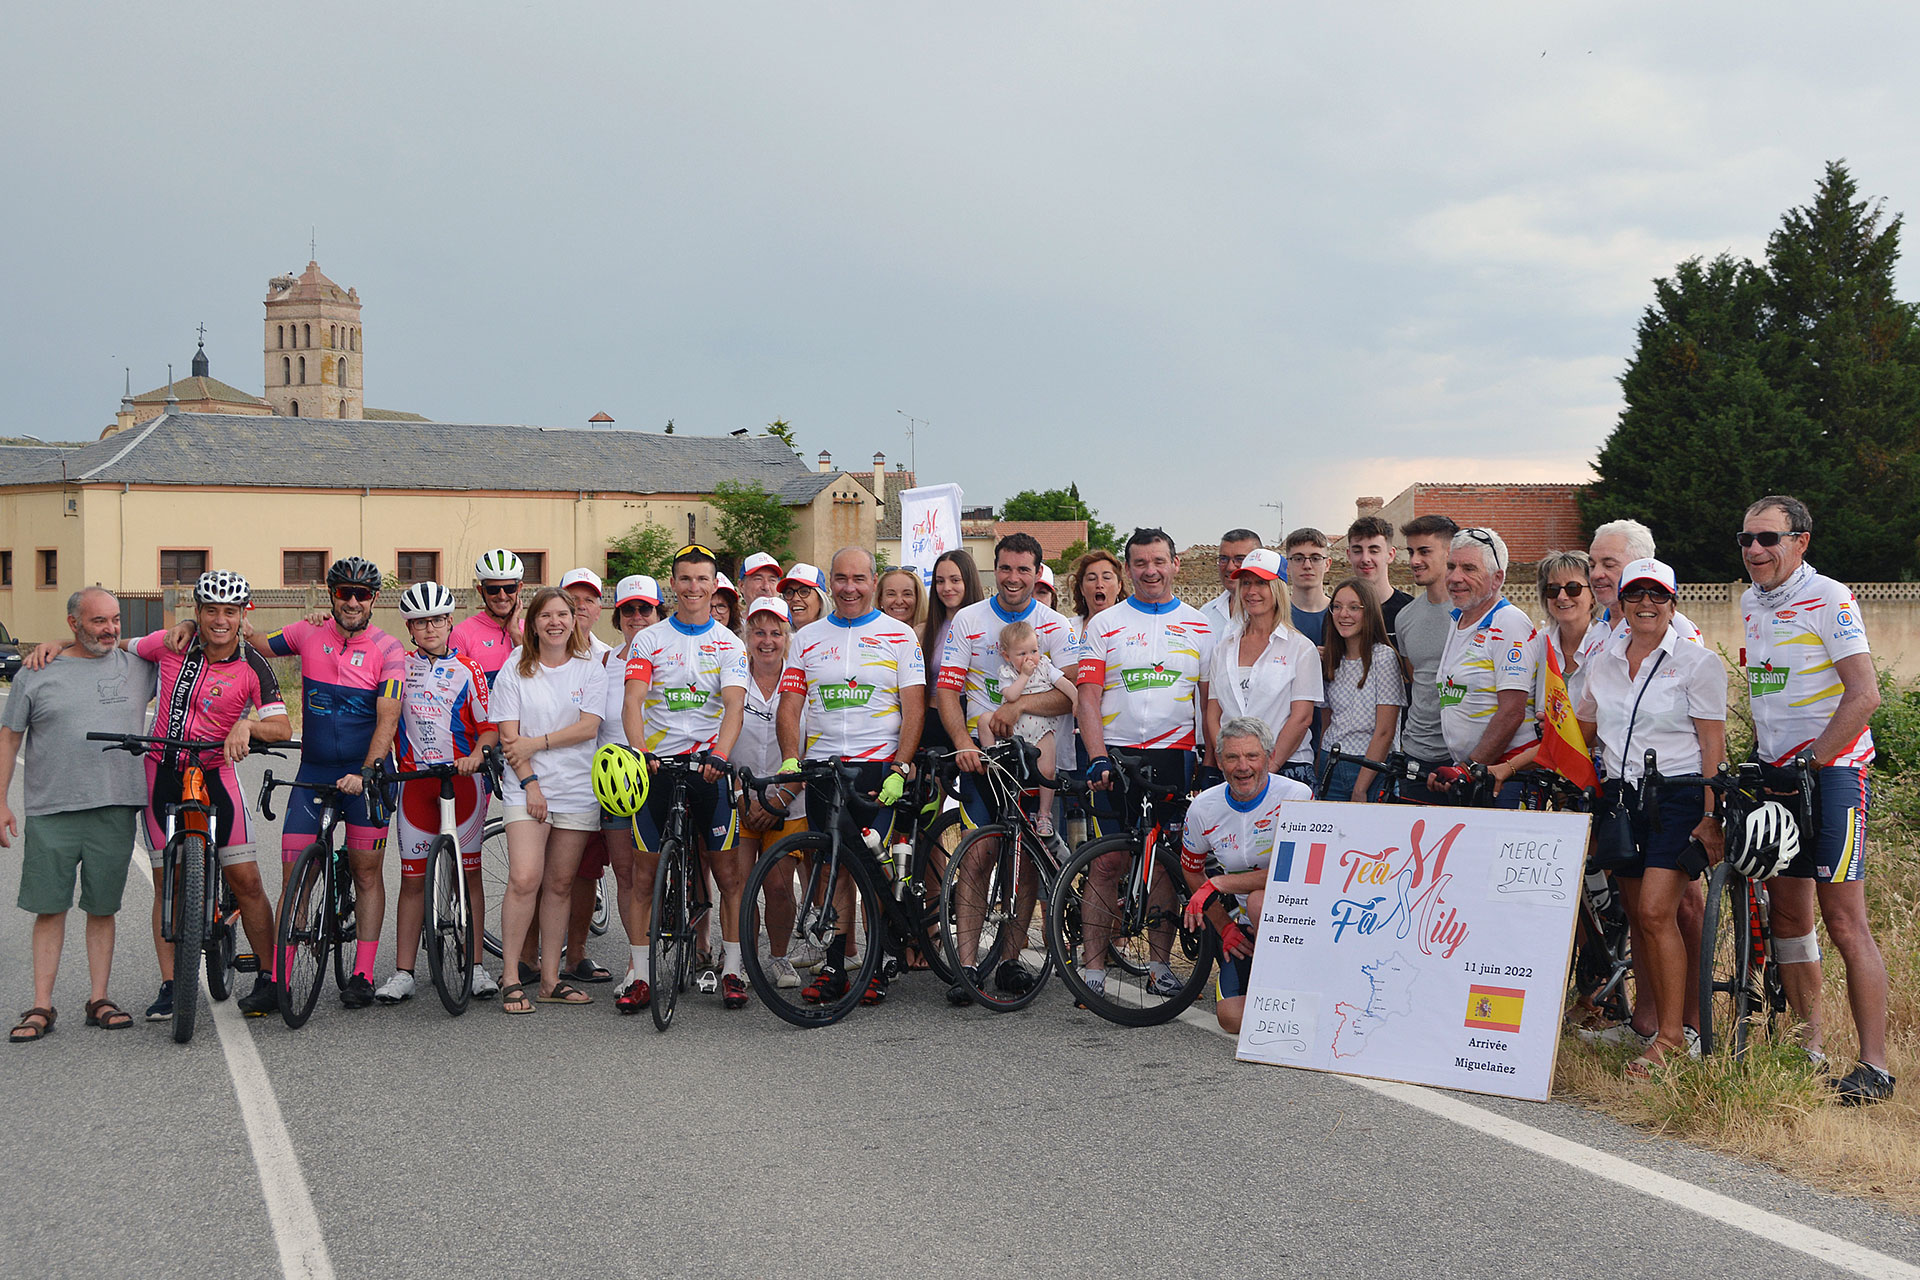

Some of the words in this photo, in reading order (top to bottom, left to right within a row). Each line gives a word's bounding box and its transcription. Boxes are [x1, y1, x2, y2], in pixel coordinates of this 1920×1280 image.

[1127, 672, 1140, 682] LE
[1142, 672, 1176, 683] SAINT
[1749, 672, 1759, 683] LE
[1760, 672, 1786, 684] SAINT
[175, 680, 190, 708] Navas
[667, 692, 679, 702] LE
[680, 692, 708, 704] SAINT
[823, 689, 835, 699] LE
[836, 689, 870, 700] SAINT
[1280, 822, 1287, 831] 4
[1287, 823, 1307, 833] juin
[1309, 823, 1334, 833] 2022
[1847, 814, 1863, 880] MMteamfamily
[1277, 895, 1309, 908] Départ
[1263, 914, 1275, 923] La
[1277, 914, 1317, 927] Bernerie
[1268, 936, 1281, 944] en
[1282, 935, 1305, 945] Retz
[1464, 962, 1477, 972] 11
[1478, 963, 1501, 976] juin
[1504, 966, 1533, 978] 2022
[1467, 1037, 1508, 1052] Arrivée
[1454, 1056, 1516, 1075] Miguelañez
